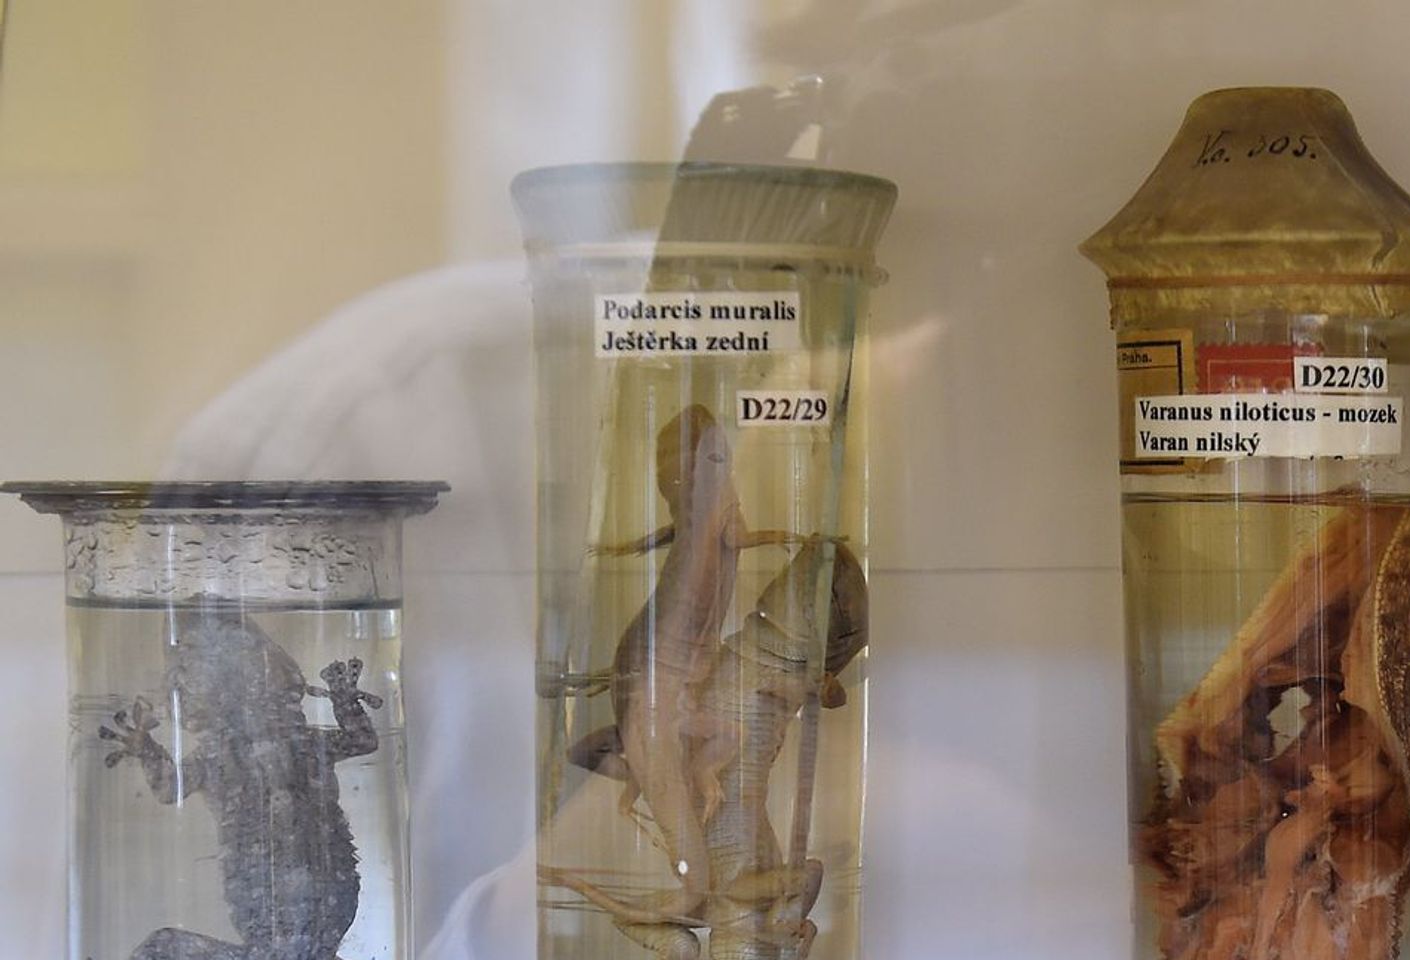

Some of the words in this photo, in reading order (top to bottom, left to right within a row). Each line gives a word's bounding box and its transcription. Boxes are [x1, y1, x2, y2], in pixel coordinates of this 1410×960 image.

[602, 300, 702, 321] Podarcis
[709, 300, 796, 322] muralis
[601, 330, 698, 351] Ještěrka
[705, 331, 770, 351] zední
[1301, 364, 1385, 390] D22/30
[741, 397, 829, 421] D22/29
[1139, 400, 1213, 422] Varanus
[1220, 401, 1317, 423] niloticus
[1338, 404, 1399, 425] mozek
[1139, 431, 1189, 451] Varan
[1196, 432, 1261, 457] nilský
